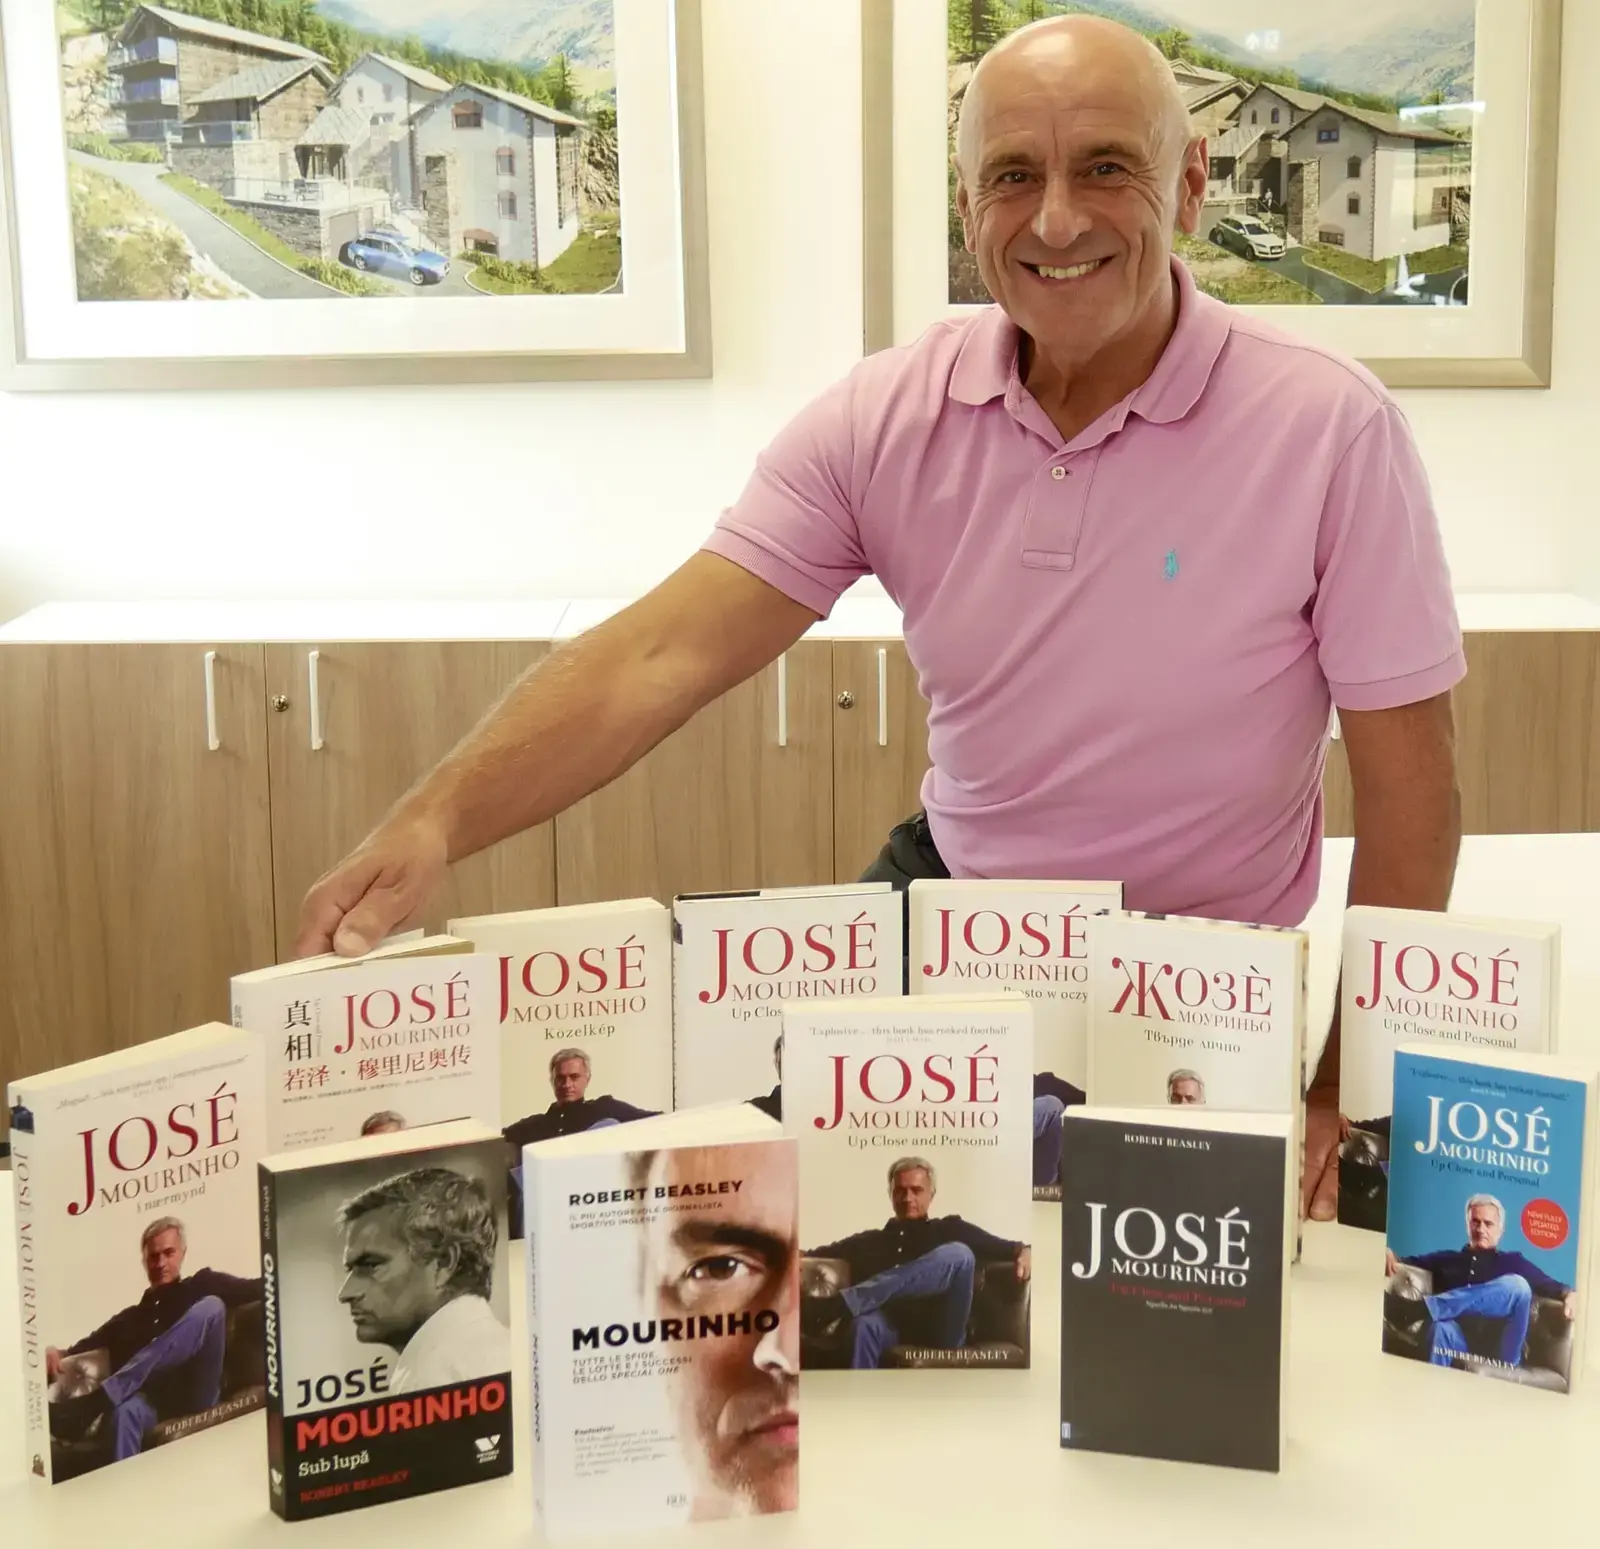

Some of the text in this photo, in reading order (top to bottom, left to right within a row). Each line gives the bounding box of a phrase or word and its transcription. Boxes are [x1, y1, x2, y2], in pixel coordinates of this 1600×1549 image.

[922, 904, 1088, 978] JOSÉ
[699, 910, 877, 1004] JOSÉ
[953, 960, 1088, 983] MOURINHO
[498, 934, 647, 1024] JOSÉ
[732, 975, 876, 1002] MOURINHO
[1355, 939, 1519, 1010] JOSÉ
[512, 995, 647, 1024] MOURINHO
[1047, 989, 1057, 999] w
[1060, 990, 1089, 1004] oczy
[334, 971, 471, 1054] JOSÉ
[731, 1005, 783, 1022] Up Clos
[1177, 1009, 1272, 1034] МОУРИНЬО
[1384, 995, 1517, 1032] MOURINHO
[284, 1000, 312, 1062] 真相
[360, 1022, 471, 1052] MOURINHO
[872, 1026, 891, 1036] this
[893, 1025, 914, 1036] book
[917, 1026, 934, 1035] has
[936, 1026, 968, 1036] rocked
[1383, 1018, 1517, 1049] Up Close and Personal
[814, 1044, 999, 1130] JOSÉ
[848, 1110, 998, 1130] MOURINHO
[1414, 1095, 1551, 1157] JOSÉ
[67, 1081, 239, 1215] JOSÉ
[848, 1134, 998, 1149] Up Close and Personal
[1124, 1133, 1212, 1151] ROBERT BEASLEY
[1439, 1140, 1550, 1175] MOURINHO
[99, 1150, 240, 1208] MOURINHO
[1431, 1158, 1540, 1188] Up Close and Personal
[569, 1180, 743, 1207] ROBERT BEASLEY
[570, 1216, 657, 1231] SPORTIVO INGLESE
[599, 1207, 661, 1219] AUTOREVOLE
[662, 1202, 723, 1214] GIORNALISTA
[1529, 1219, 1560, 1232] UPDATED
[1072, 1202, 1250, 1279] JOSÉ
[1111, 1258, 1248, 1288] MOURINHO
[264, 1253, 280, 1398] MOURINHO
[572, 1308, 780, 1351] MOURINHO
[572, 1366, 585, 1376] LE
[589, 1362, 621, 1374] LOTTE
[642, 1355, 693, 1369] SUCCESSI
[573, 1355, 605, 1367] TUTTE
[609, 1354, 621, 1363] LE
[905, 1349, 1009, 1361] ROBERT BEASLEY
[1433, 1344, 1473, 1361] ROBERT
[297, 1356, 389, 1409] JOSÉ
[573, 1365, 680, 1385] DELLO SPECIAL ONE
[165, 1411, 208, 1436] ROBERT
[296, 1380, 506, 1452] MOURINHO
[298, 1450, 370, 1477] Sub lupă
[299, 1470, 411, 1503] ROBERT BEASLEY
